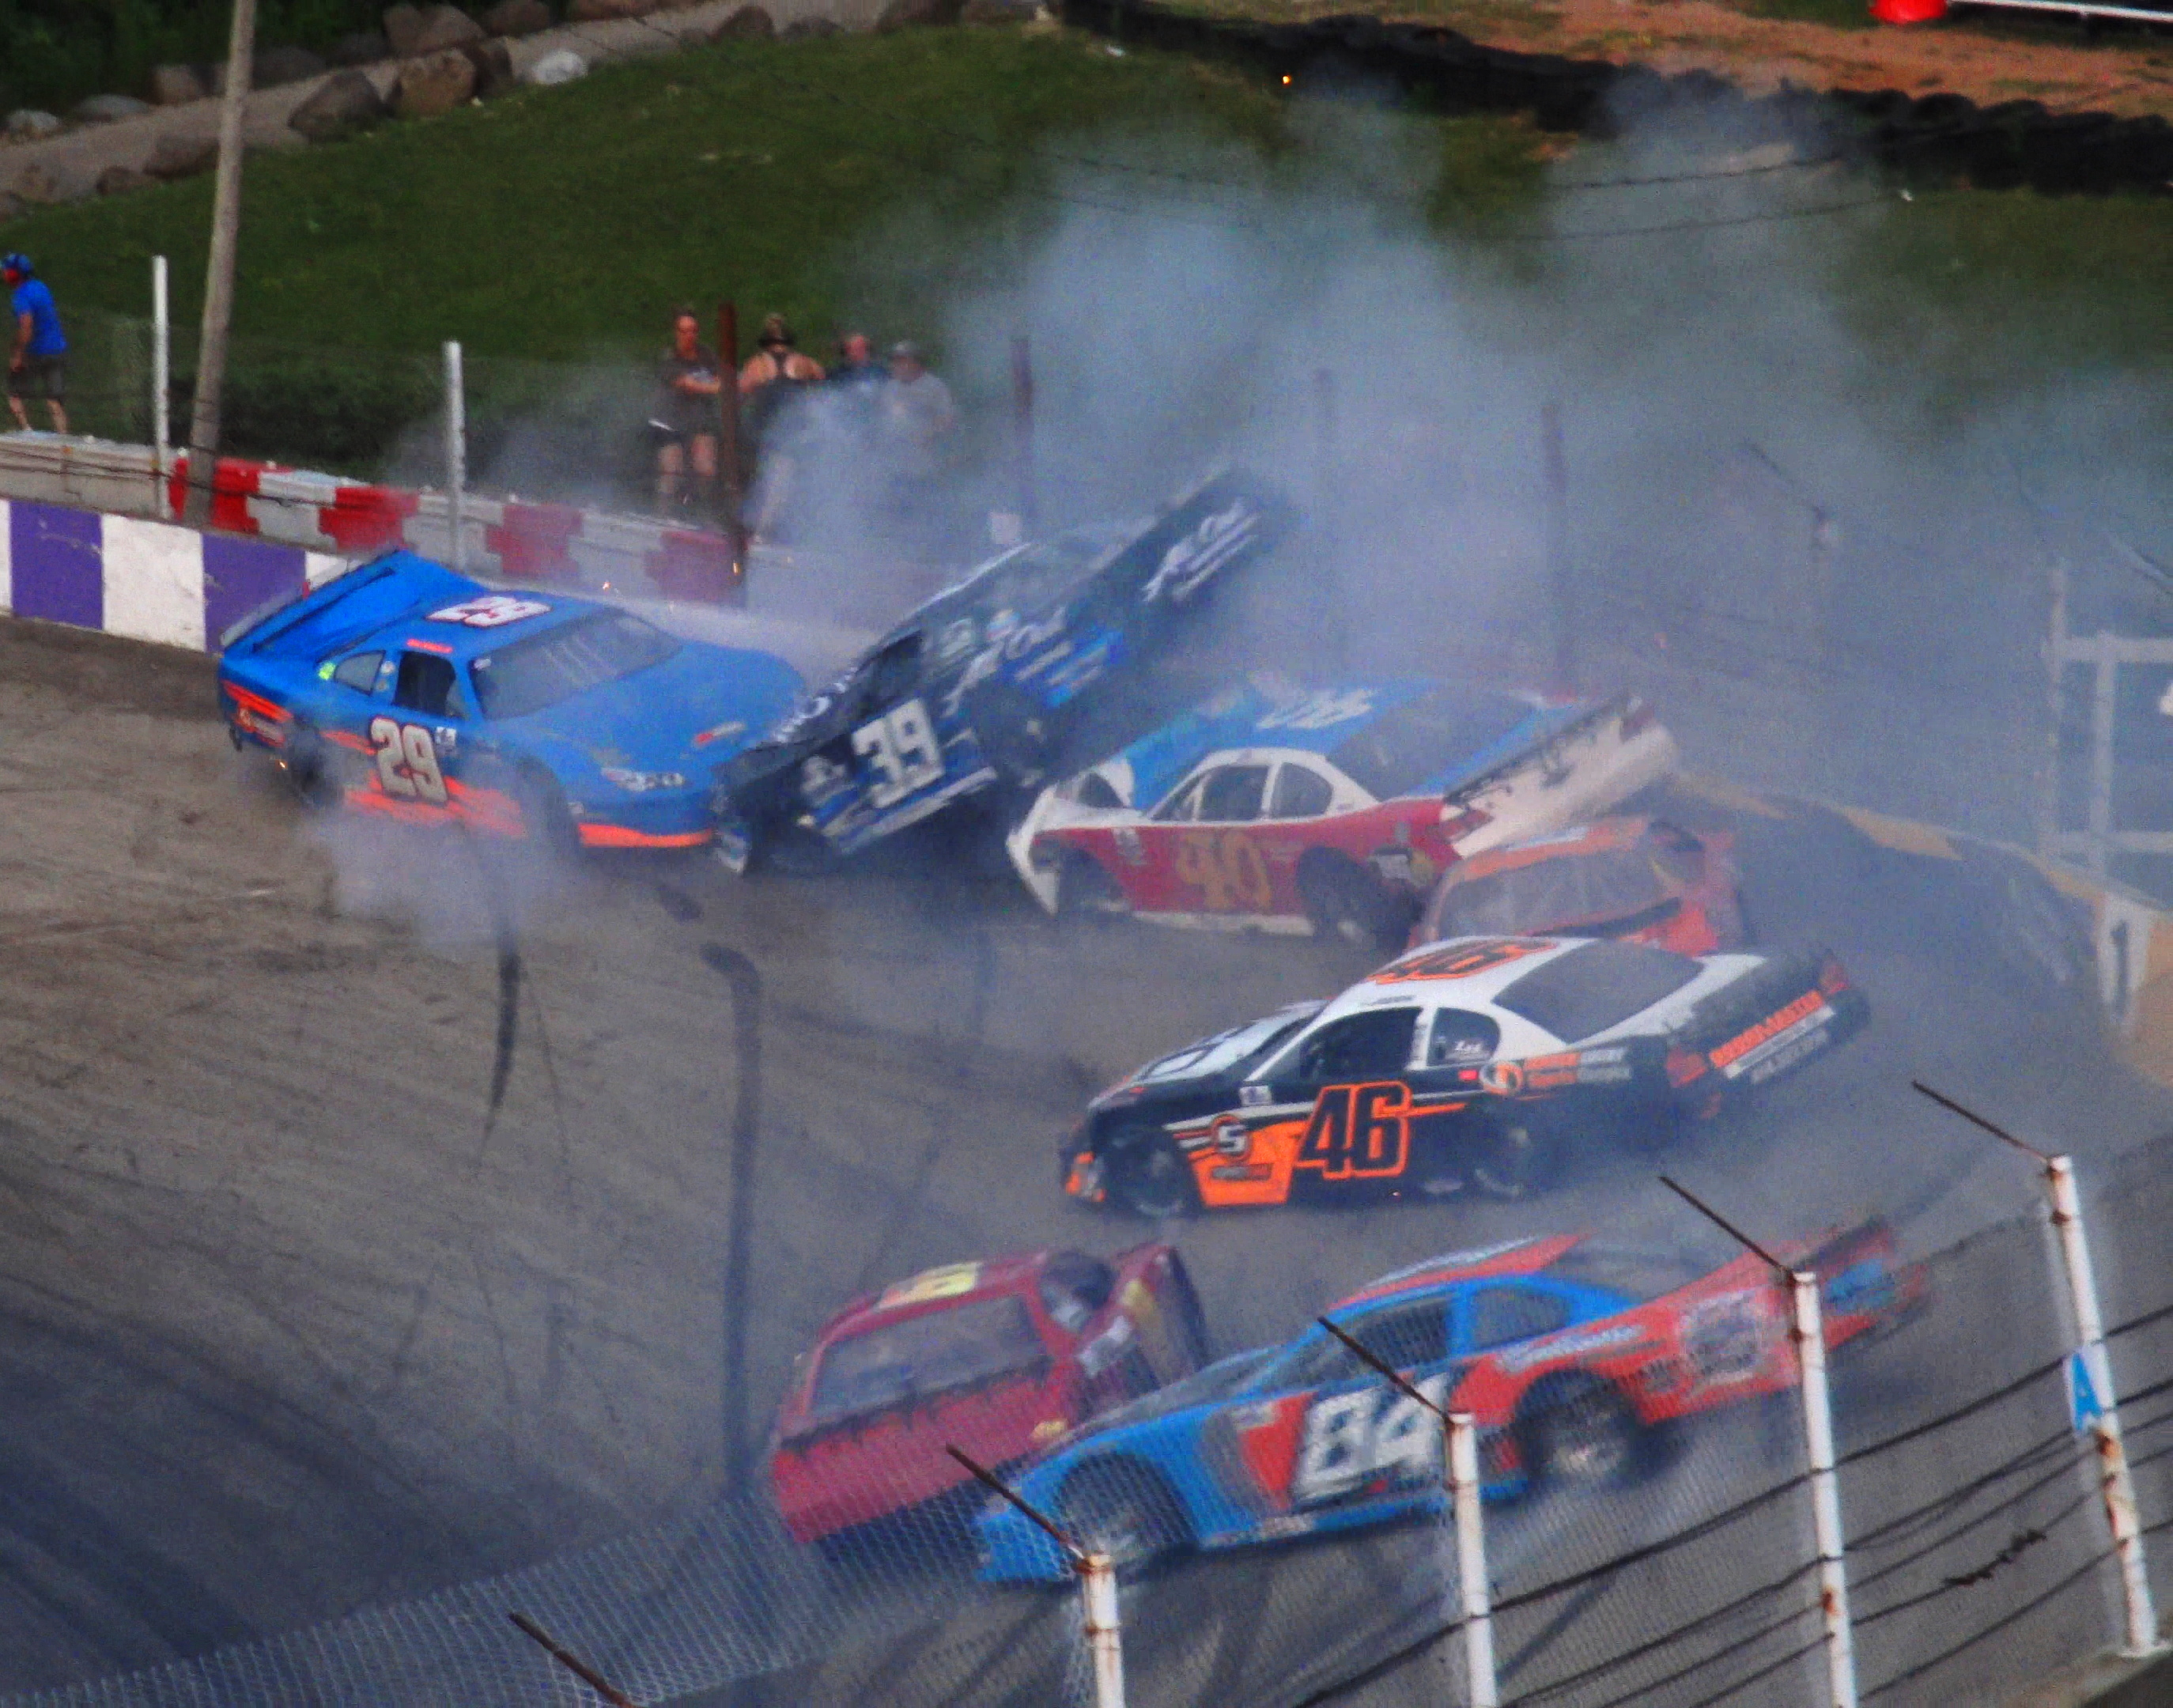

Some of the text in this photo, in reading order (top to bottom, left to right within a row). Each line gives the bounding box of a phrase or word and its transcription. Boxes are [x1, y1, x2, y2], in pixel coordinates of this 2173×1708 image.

[368, 716, 448, 803] 29
[851, 698, 947, 809] 39
[1175, 827, 1272, 911] 40
[1294, 1080, 1414, 1181] 46
[1295, 1372, 1450, 1501] 84
